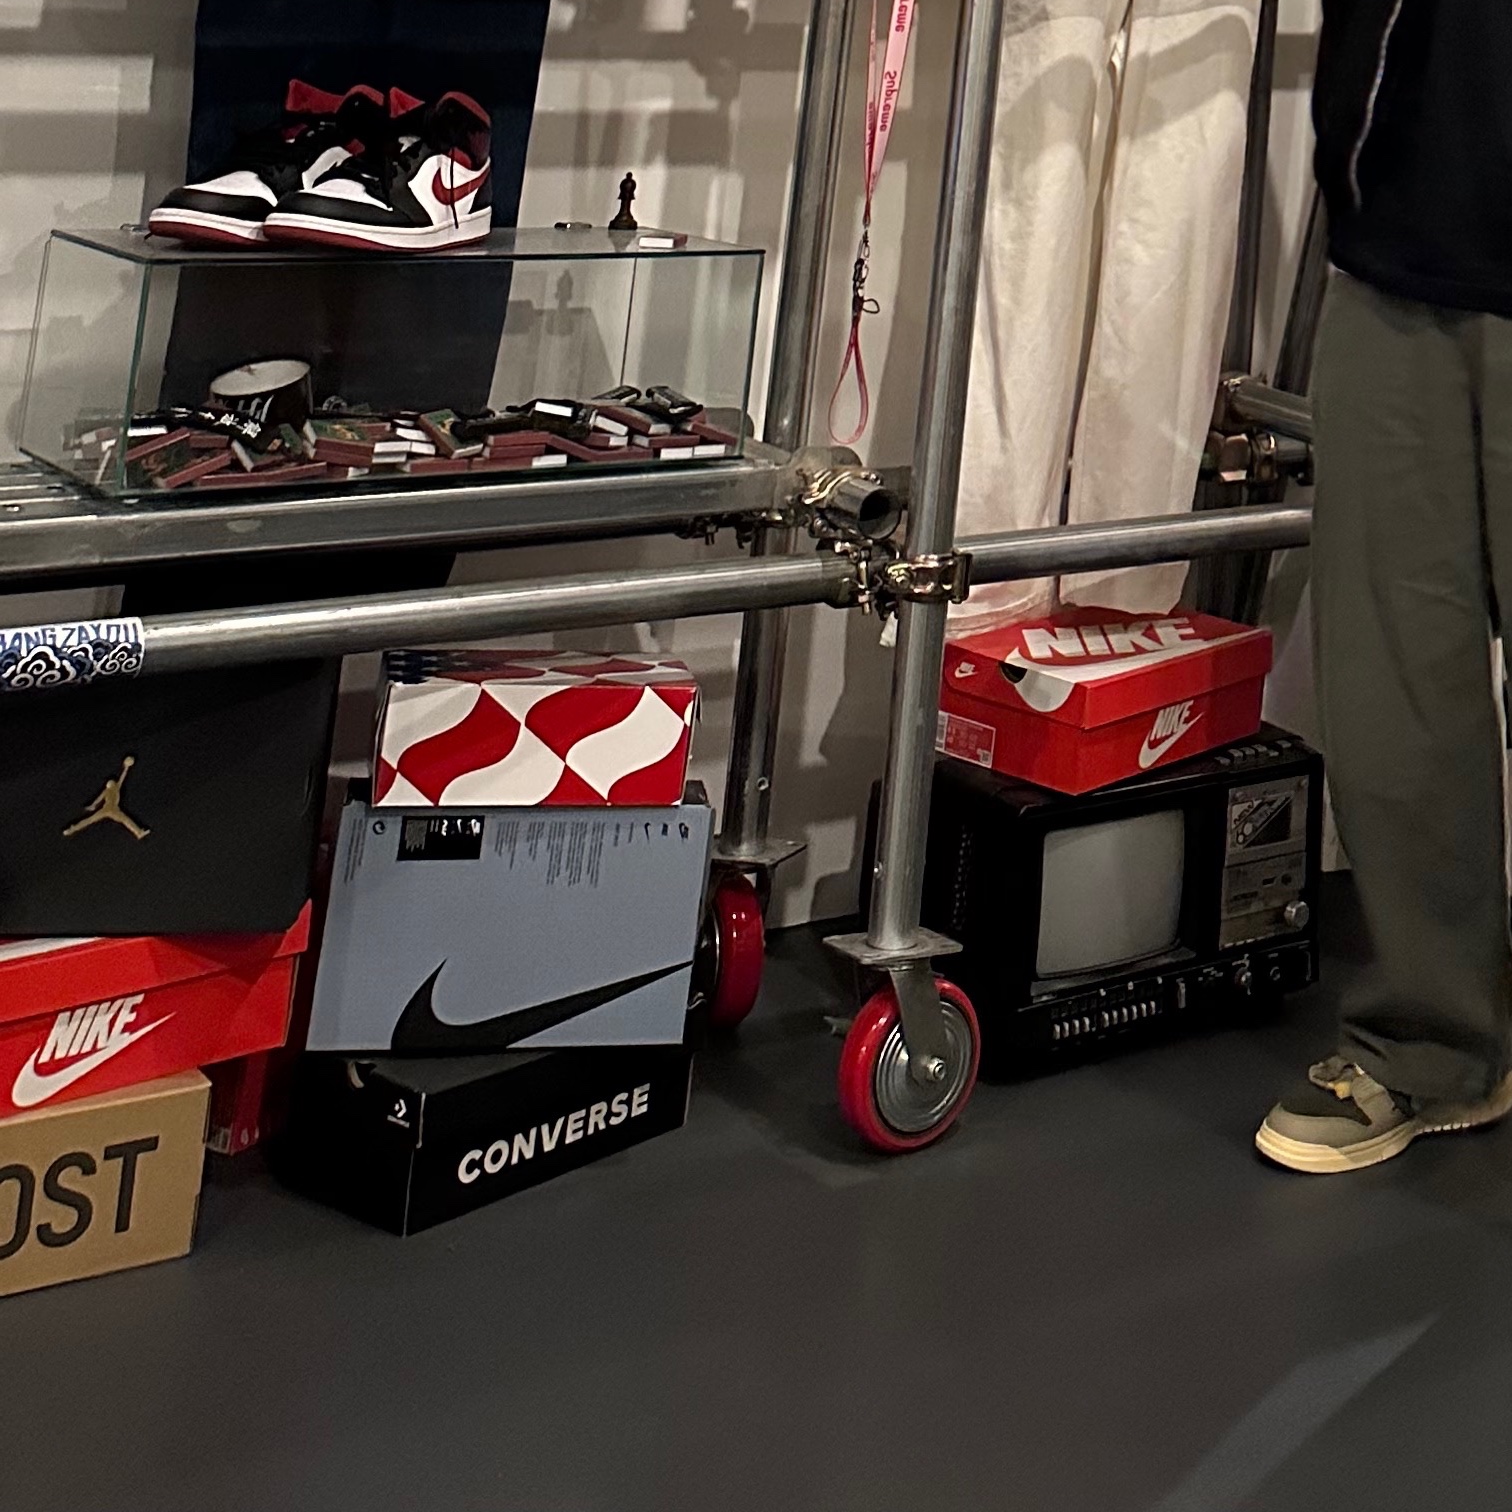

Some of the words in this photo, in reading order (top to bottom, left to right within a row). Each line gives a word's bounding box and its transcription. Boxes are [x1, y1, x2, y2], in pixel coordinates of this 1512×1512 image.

[1021, 617, 1196, 660] NIKE
[1150, 700, 1195, 740] NIKE
[37, 993, 146, 1063] NIKE
[457, 1084, 651, 1186] CONVERSE
